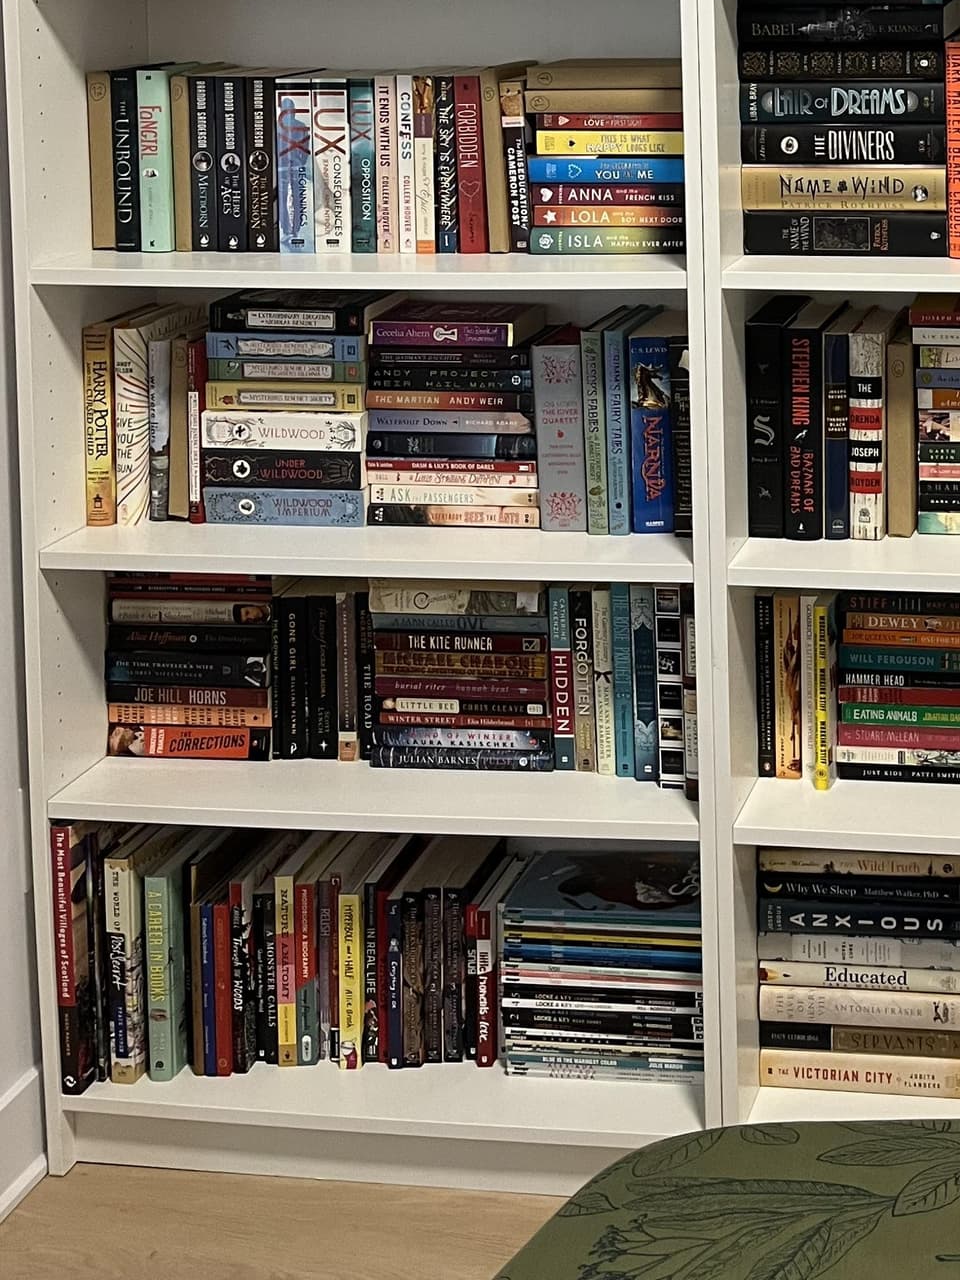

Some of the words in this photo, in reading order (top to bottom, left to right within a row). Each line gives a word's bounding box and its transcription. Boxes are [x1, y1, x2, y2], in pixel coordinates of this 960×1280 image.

[379, 86, 389, 96] IT
[831, 87, 906, 115] DREAMS
[278, 92, 310, 156] LUX
[312, 91, 346, 156] LUX
[379, 98, 390, 130] ENDS
[379, 132, 390, 152] WITH
[458, 103, 477, 168] FORBIDDEN
[828, 131, 895, 160] DIVINERS
[380, 155, 390, 167] US
[114, 119, 132, 224] UNBOUND
[361, 158, 370, 220] OPPOSITION
[568, 189, 613, 201] ANNA
[570, 211, 610, 223] LOLA
[568, 235, 603, 247] ISLA
[792, 338, 809, 393] STEPHEN
[93, 360, 106, 405] HARRY
[858, 383, 872, 393] THE
[375, 396, 395, 404] THE
[398, 396, 440, 404] MARTIAN
[450, 397, 477, 405] ANDY
[480, 397, 503, 405] WEIR
[793, 397, 809, 426] KING
[94, 408, 108, 460] POTTER
[258, 428, 326, 439] WILDWOOD
[642, 416, 666, 500] NARNIA
[851, 446, 879, 457] JOSEPH
[868, 618, 920, 628] DEWEY
[408, 636, 428, 649] THE
[430, 636, 451, 649] KITE
[455, 636, 493, 651] RUNNER
[575, 618, 590, 715] FORGOTTEN
[846, 674, 880, 685] HAMMER
[884, 675, 905, 686] HEAD
[134, 688, 154, 702] JOE
[158, 688, 182, 702] HILL
[189, 690, 227, 705] HORNS
[554, 655, 569, 731] HIDDEN
[169, 733, 245, 752] CORRECTIONS
[786, 882, 810, 894] Why
[813, 884, 827, 894] We
[830, 885, 856, 897] Sleep
[367, 940, 375, 967] REAL
[367, 970, 376, 994] LIFE
[825, 968, 907, 986] Educated
[794, 1067, 859, 1082] VICTORIAN
[865, 1070, 892, 1082] CITY
